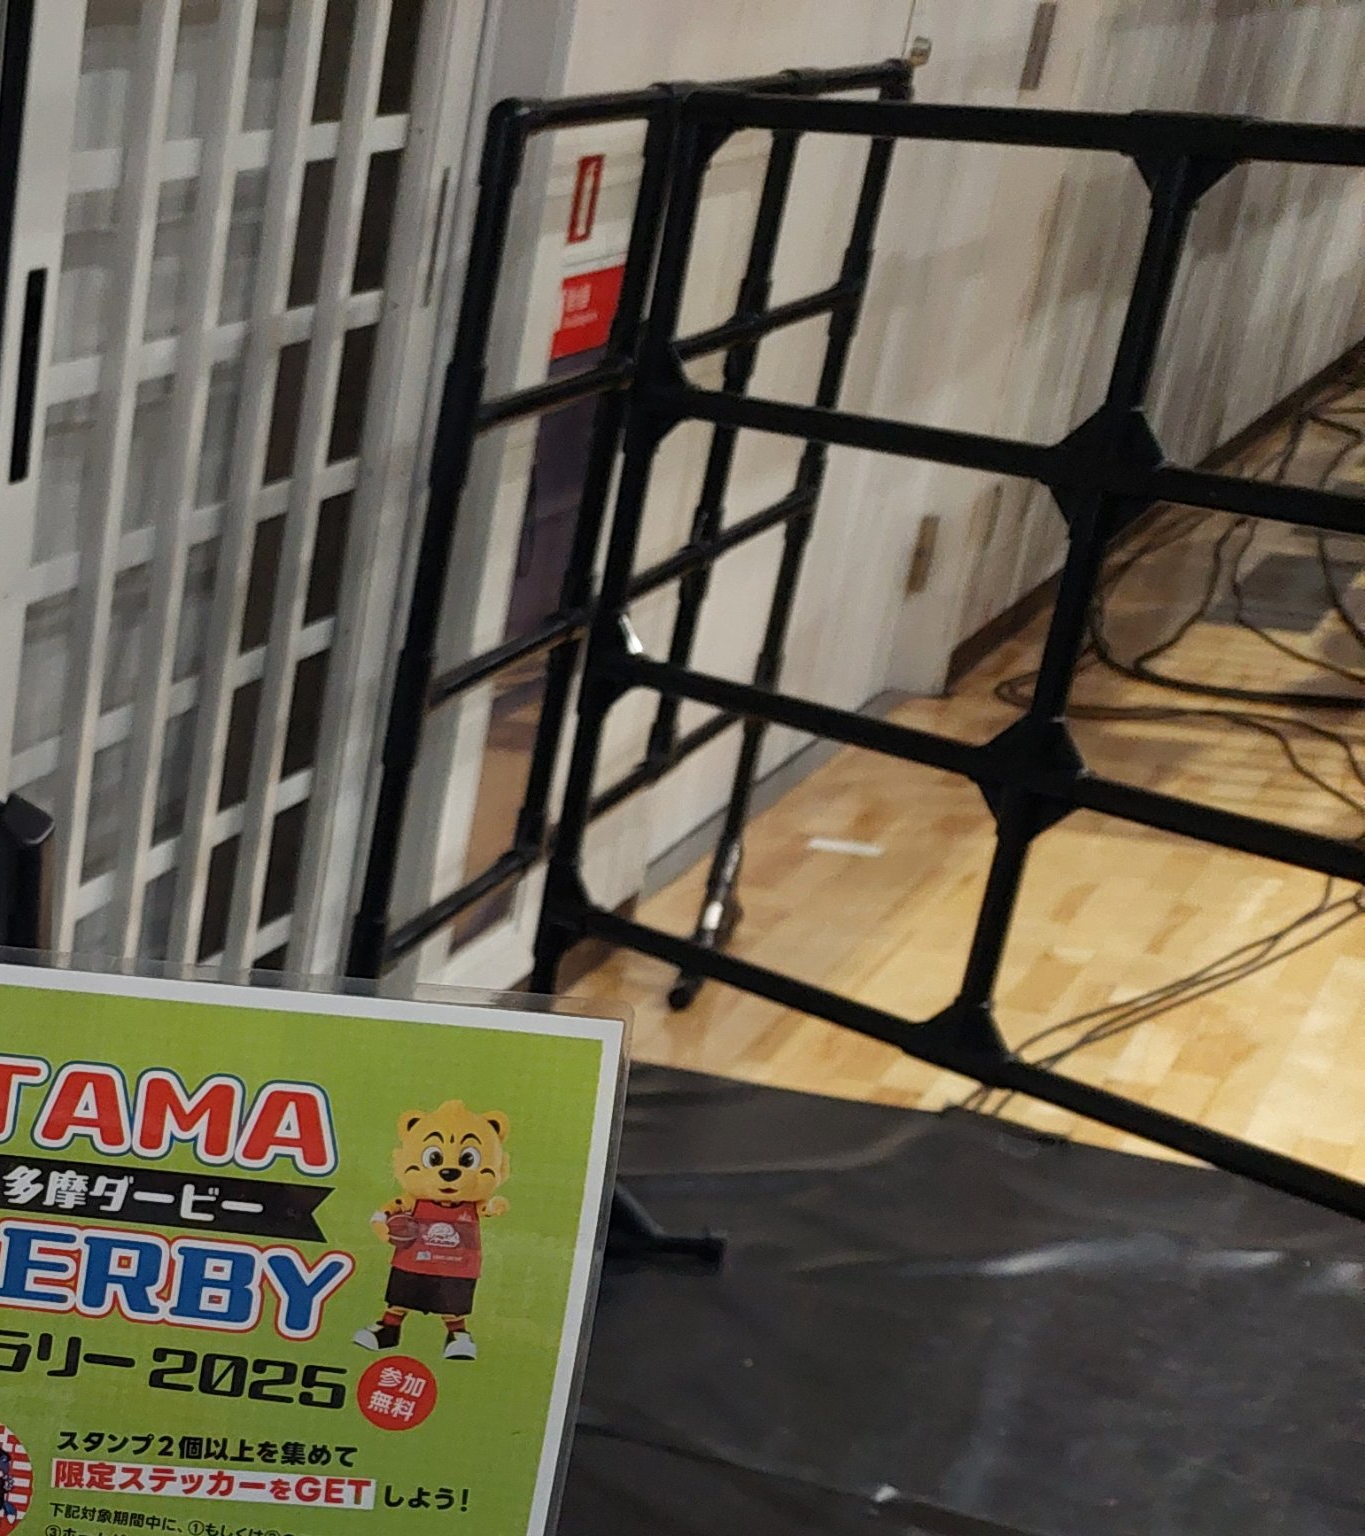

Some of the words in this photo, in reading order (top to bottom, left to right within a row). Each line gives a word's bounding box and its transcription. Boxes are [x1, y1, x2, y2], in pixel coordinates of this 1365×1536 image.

[1, 1164, 265, 1224] 多摩ダービー
[149, 1345, 348, 1411] 2025
[377, 1365, 426, 1398] 参加
[368, 1387, 417, 1422] 無料
[56, 1430, 359, 1468] スタンプ2個以上を集めて
[54, 1459, 372, 1507] 限定ステッカーをGET
